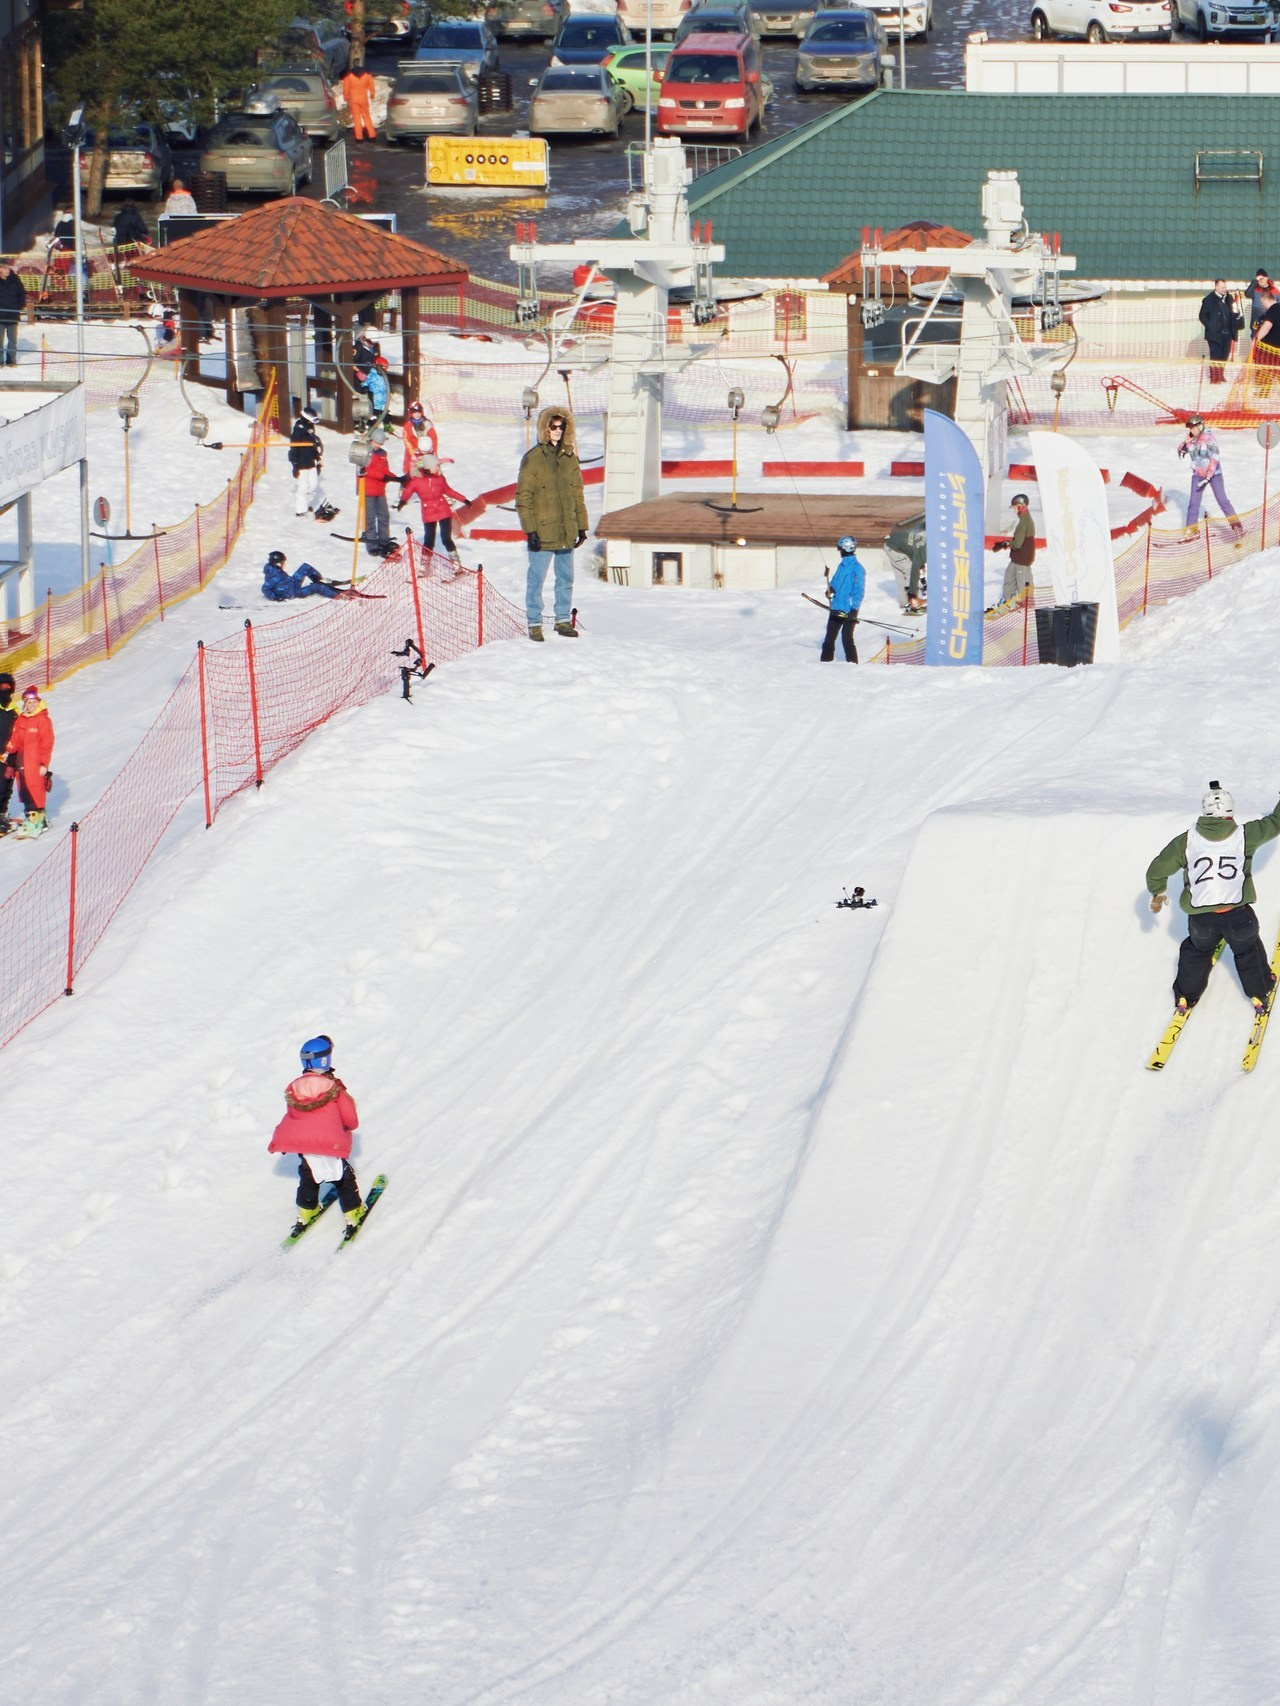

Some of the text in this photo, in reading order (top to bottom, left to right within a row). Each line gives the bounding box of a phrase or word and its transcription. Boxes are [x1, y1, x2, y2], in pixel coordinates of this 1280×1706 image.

[939, 472, 948, 655] ГОРНОЛЫЖНЫЙ КУРОРТ
[947, 472, 970, 660] СНЕЖНЫЙ
[1193, 856, 1238, 885] 25
